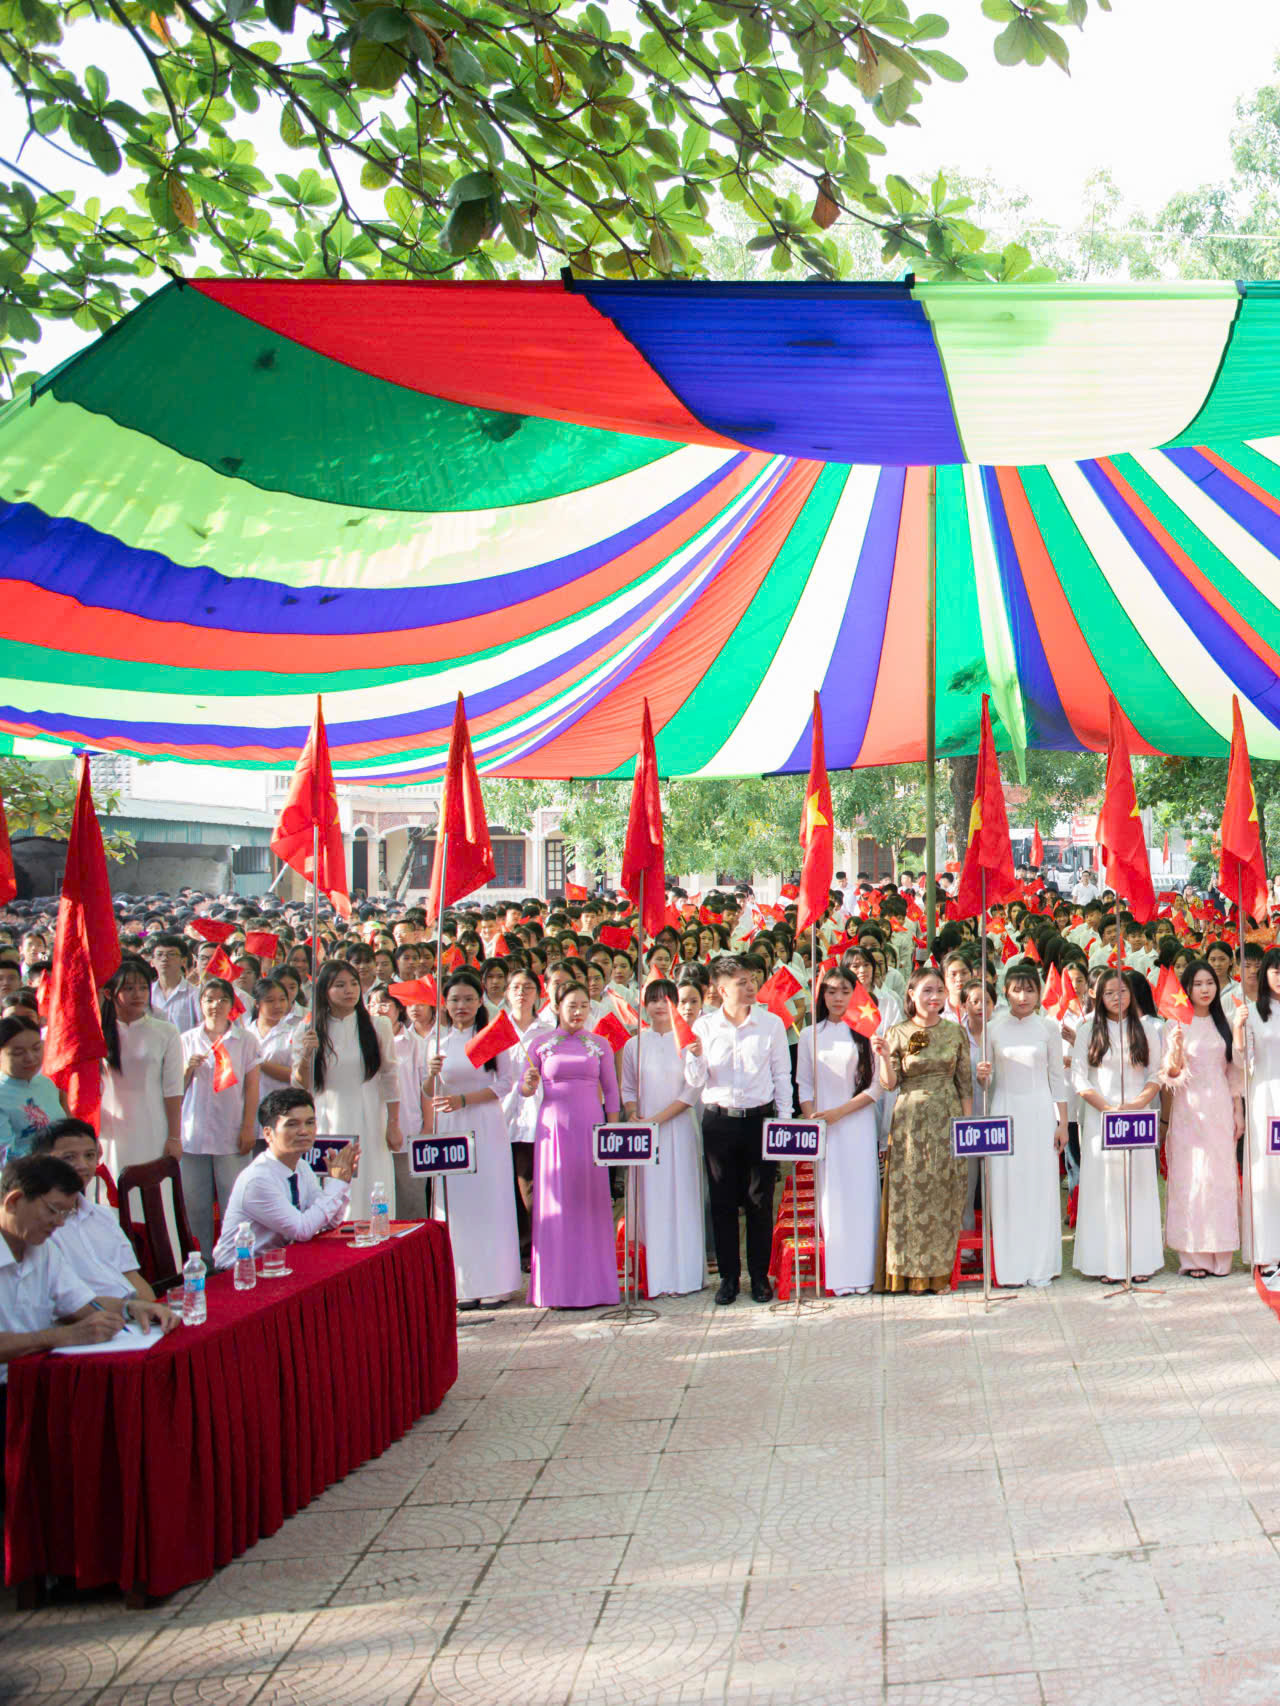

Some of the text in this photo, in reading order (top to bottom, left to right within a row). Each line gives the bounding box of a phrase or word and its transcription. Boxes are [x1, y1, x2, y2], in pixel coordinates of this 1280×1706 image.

[958, 1125, 1006, 1146] LỚP 10H
[1108, 1119, 1130, 1138] LỚP
[600, 1134, 649, 1152] LỚP 10E
[768, 1129, 817, 1149] LỚP 10G
[415, 1143, 466, 1166] LỚP 10D
